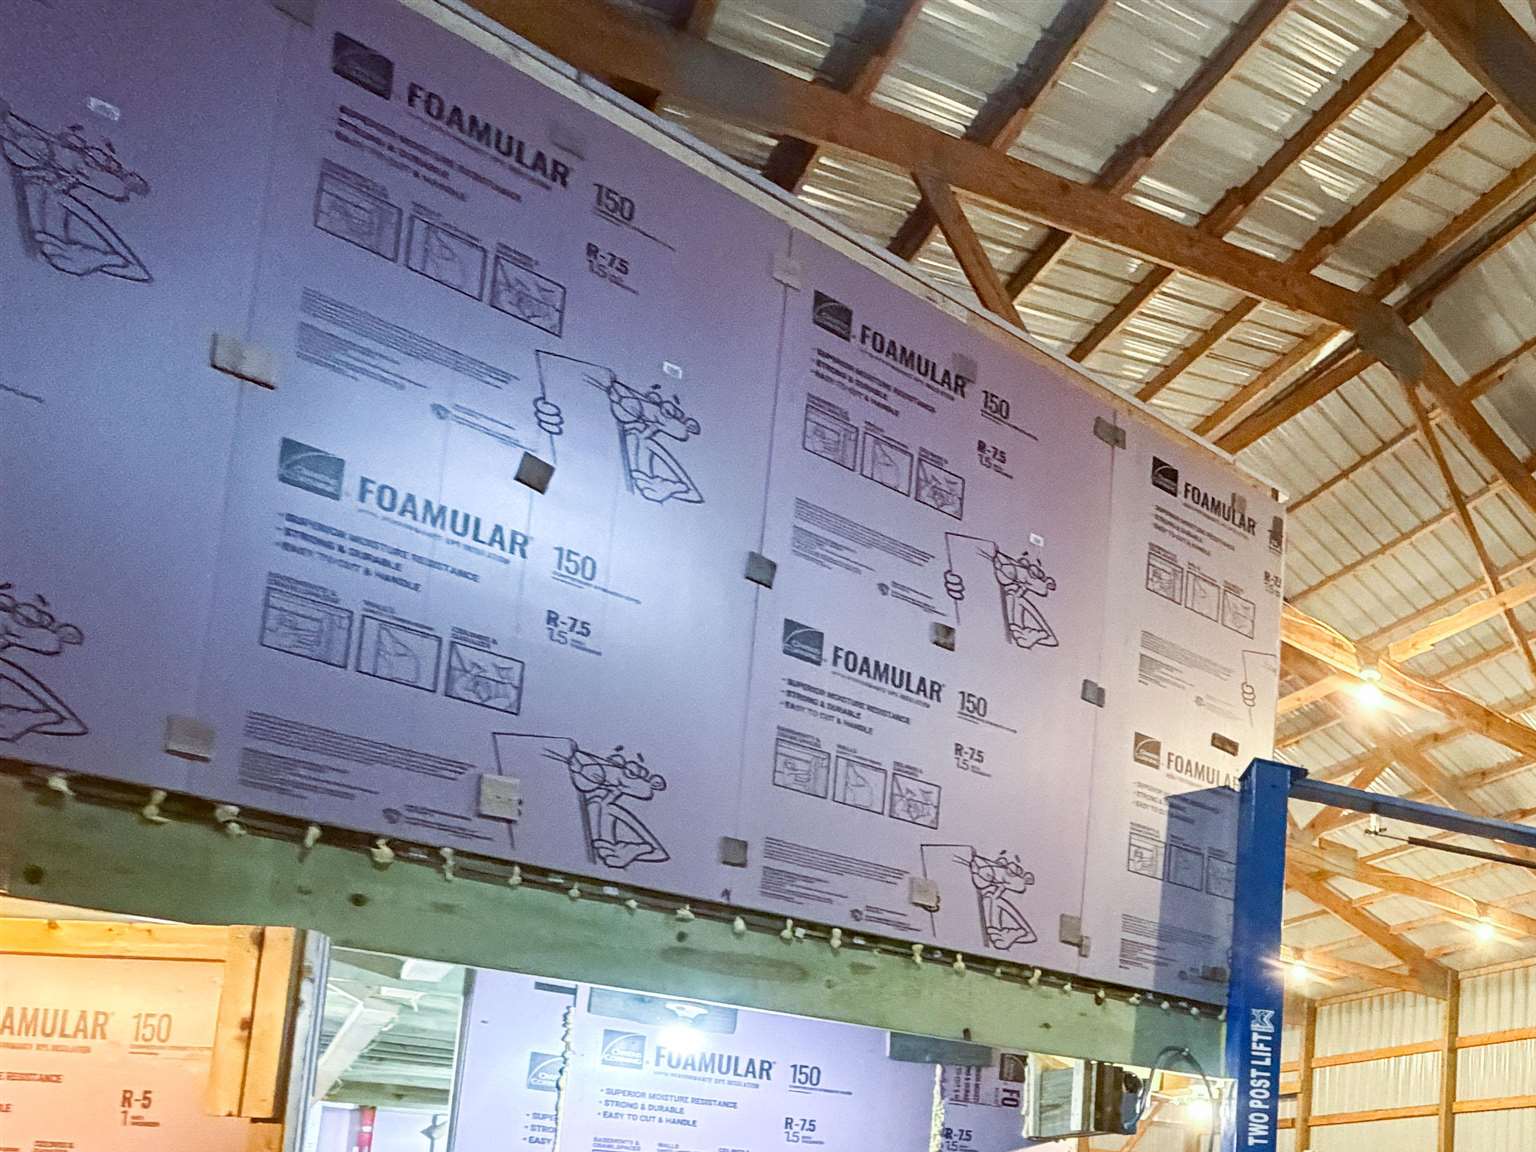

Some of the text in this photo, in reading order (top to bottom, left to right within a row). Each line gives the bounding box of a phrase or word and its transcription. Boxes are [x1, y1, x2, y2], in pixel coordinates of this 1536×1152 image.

[406, 82, 572, 189] FOAMULAR
[593, 183, 636, 222] 150
[859, 324, 968, 400] FOAMULAR
[981, 390, 1010, 419] 150
[357, 476, 530, 560] FOAMULAR
[554, 546, 597, 581] 150
[1184, 482, 1257, 536] FOAMULAR
[832, 645, 943, 703] FOAMULAR
[958, 691, 988, 718] 150
[132, 1013, 173, 1043] 150
[654, 1046, 773, 1081] FOAMULAR
[790, 1064, 821, 1087] 150
[1248, 1031, 1272, 1146] TWO POST LIFT
[121, 1090, 152, 1109] R-5
[784, 1117, 816, 1132] R-7.5
